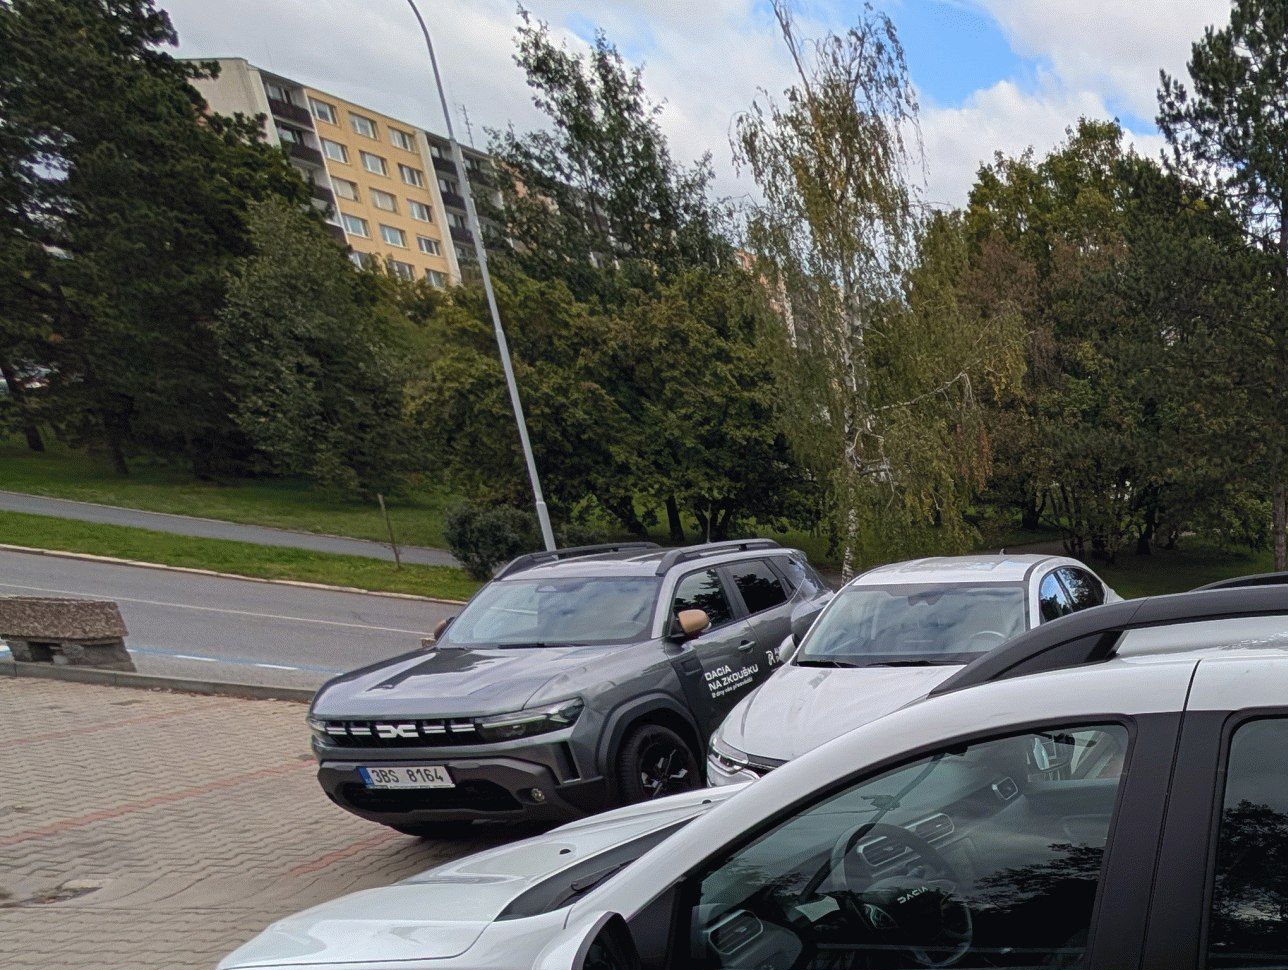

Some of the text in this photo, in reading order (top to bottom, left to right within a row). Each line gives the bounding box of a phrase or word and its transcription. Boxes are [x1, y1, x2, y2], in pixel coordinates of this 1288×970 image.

[704, 665, 732, 681] DACIA
[708, 680, 723, 692] NA
[723, 664, 759, 685] ZKOUŠKU
[371, 768, 444, 784] 3BS 8164
[896, 885, 929, 905] DACIA
